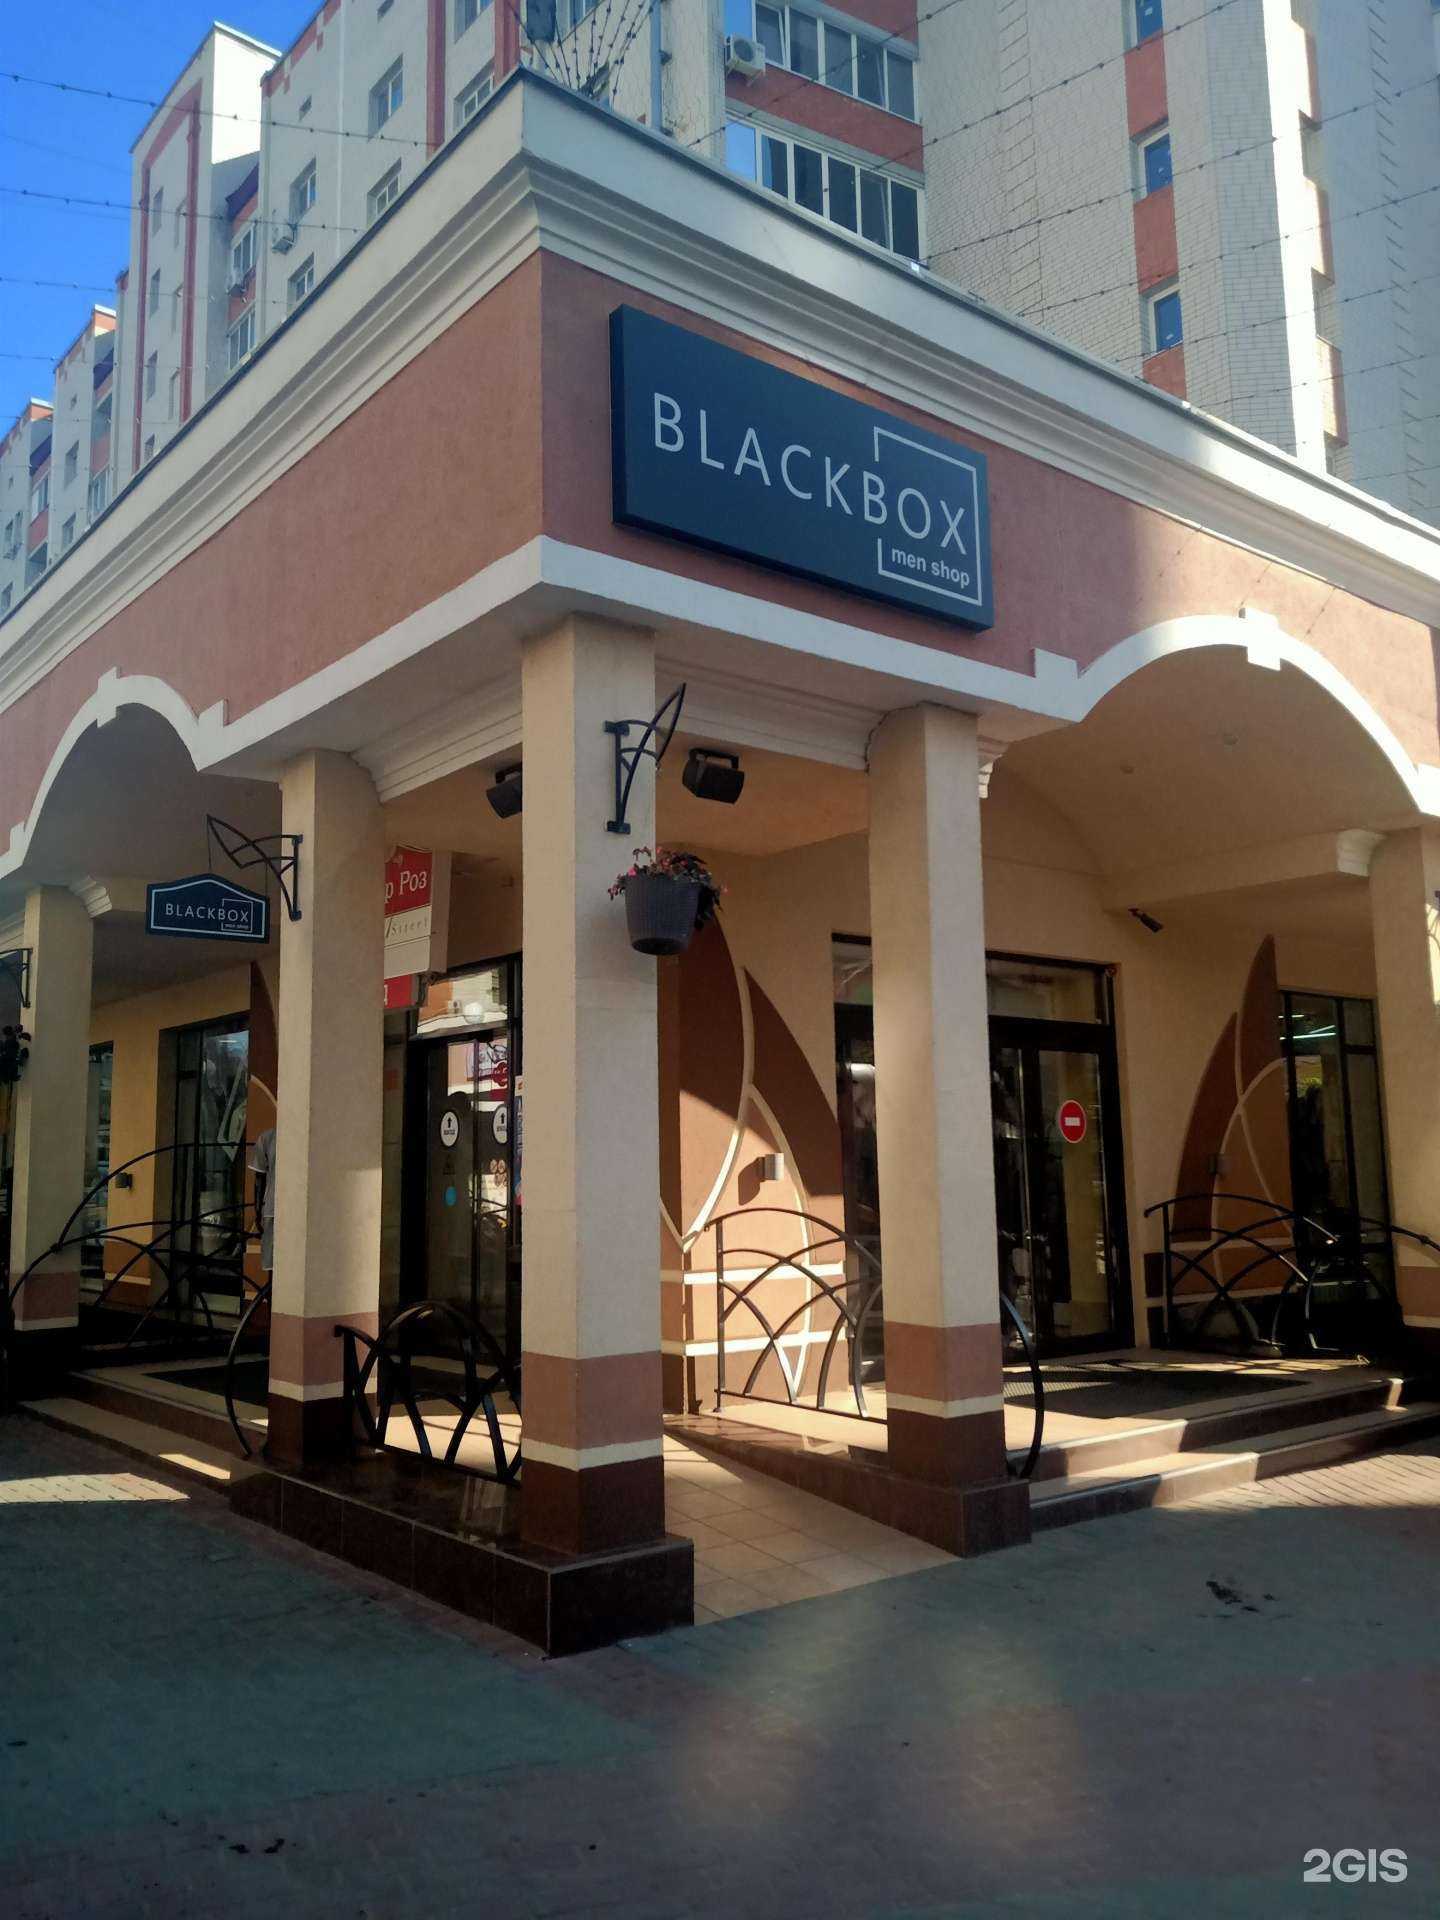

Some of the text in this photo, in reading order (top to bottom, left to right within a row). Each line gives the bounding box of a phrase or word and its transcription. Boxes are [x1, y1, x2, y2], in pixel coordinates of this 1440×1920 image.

[653, 392, 967, 555] BLACKBOX
[891, 547, 970, 589] men shop
[165, 903, 249, 922] BLACKBOX
